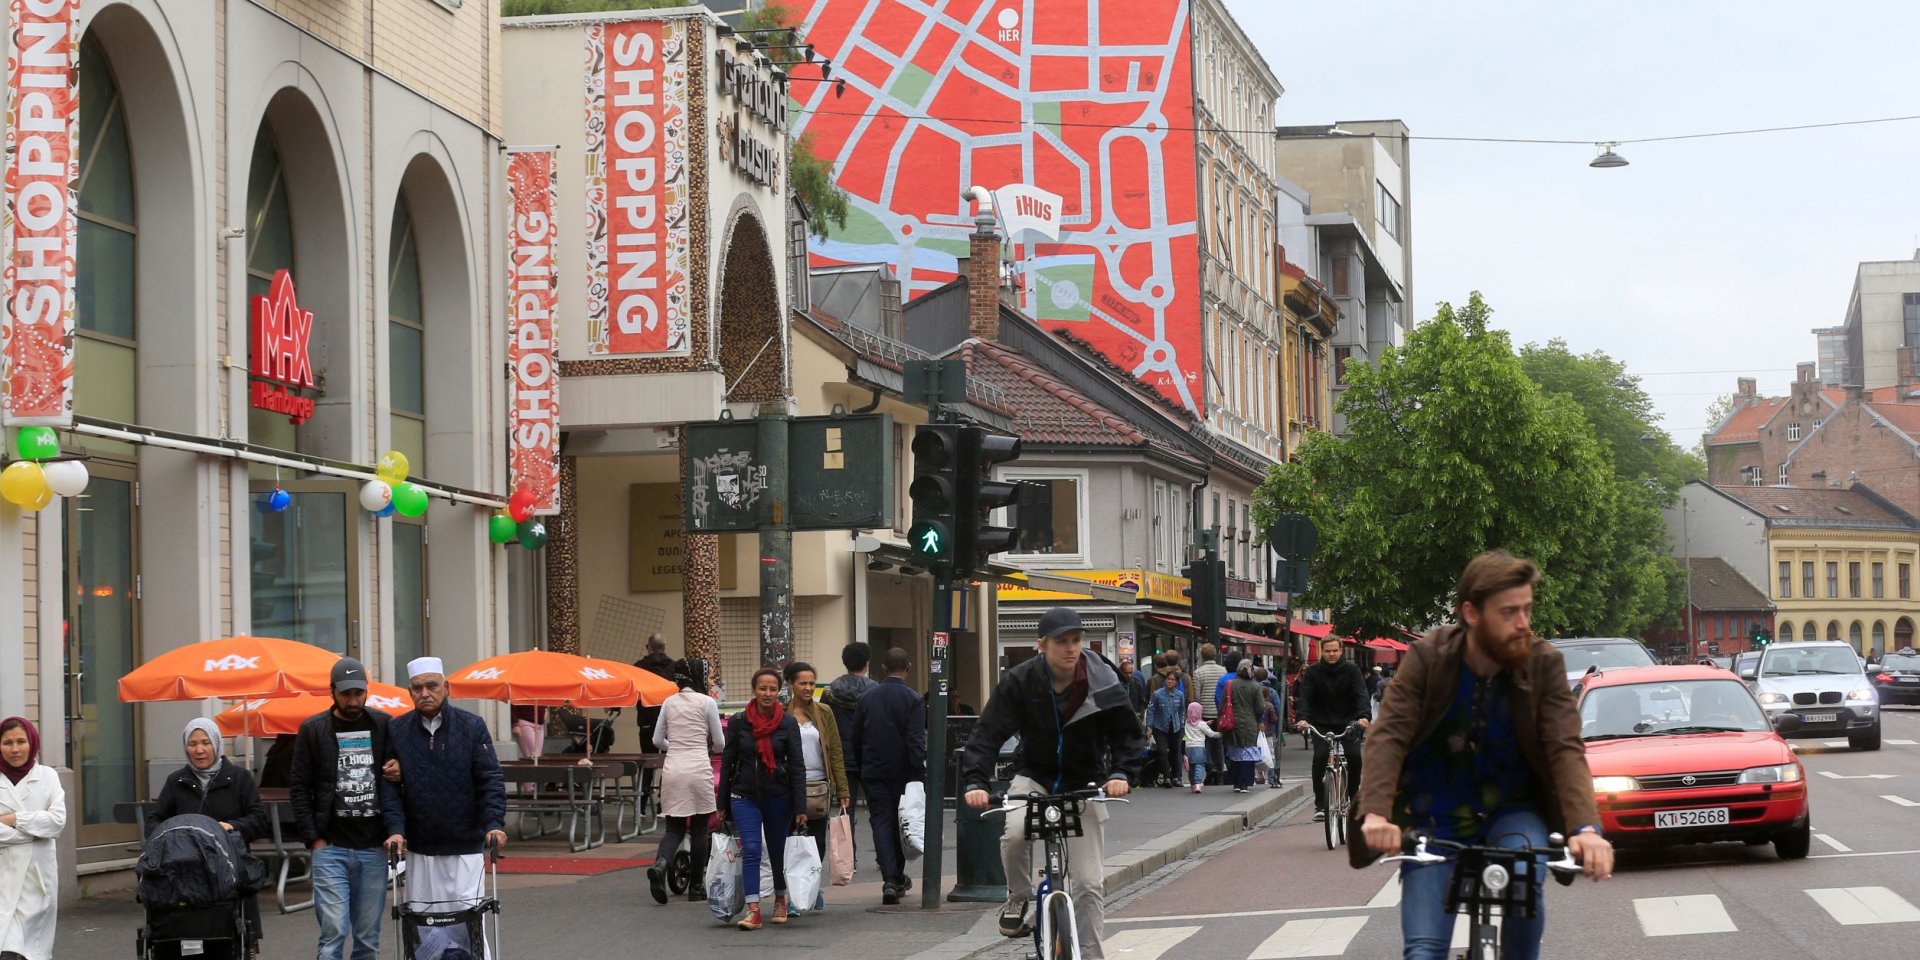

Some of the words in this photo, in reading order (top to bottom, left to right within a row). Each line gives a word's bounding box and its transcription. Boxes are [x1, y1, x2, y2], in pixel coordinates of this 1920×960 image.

[998, 30, 1020, 42] HER
[613, 31, 659, 335] SHOPPING
[260, 271, 314, 386] MAX
[516, 210, 551, 450] SHOPPING
[204, 654, 261, 672] MAX
[464, 666, 506, 680] MAX
[1658, 813, 1675, 827] KT
[1679, 809, 1726, 825] 52668
